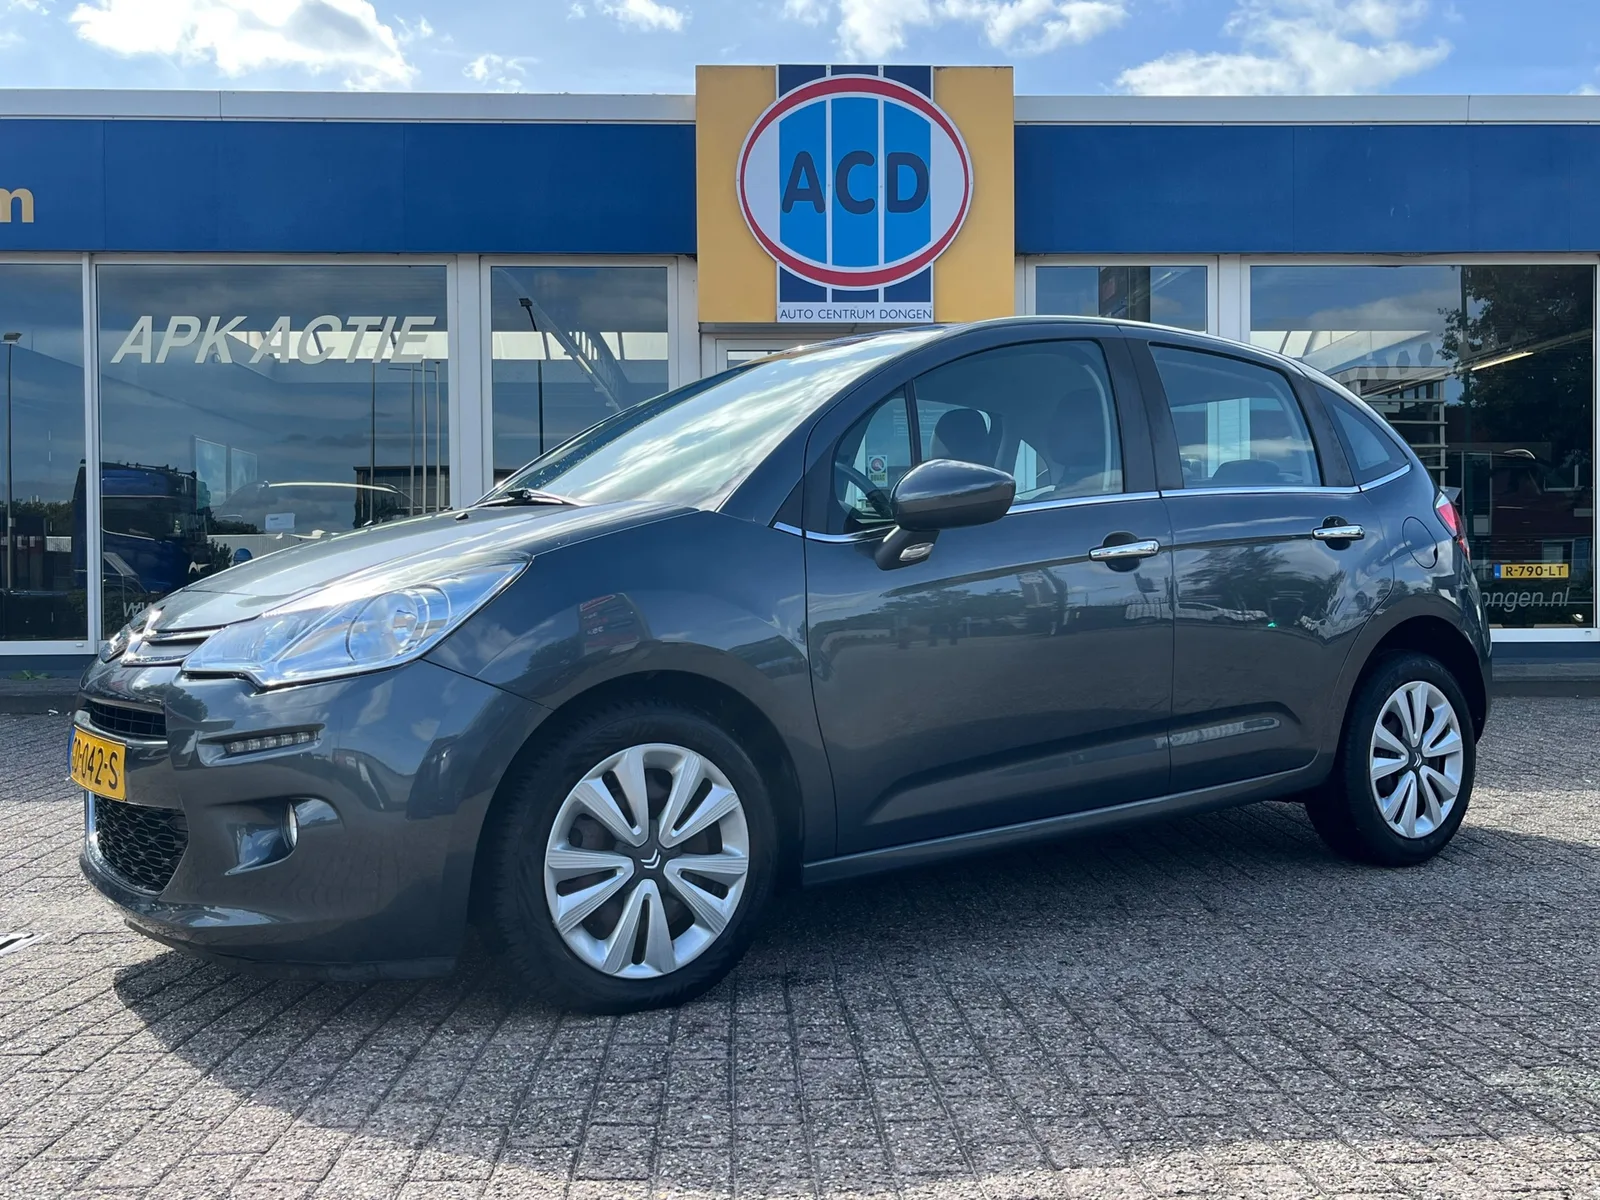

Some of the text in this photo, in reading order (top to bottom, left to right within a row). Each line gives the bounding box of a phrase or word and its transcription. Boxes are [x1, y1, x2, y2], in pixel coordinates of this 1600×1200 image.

[781, 150, 930, 215] ACD
[780, 309, 932, 320] AUTO CENTRUM DONGEN
[110, 314, 437, 366] APK ACTIE
[1505, 565, 1564, 577] R-790-LT
